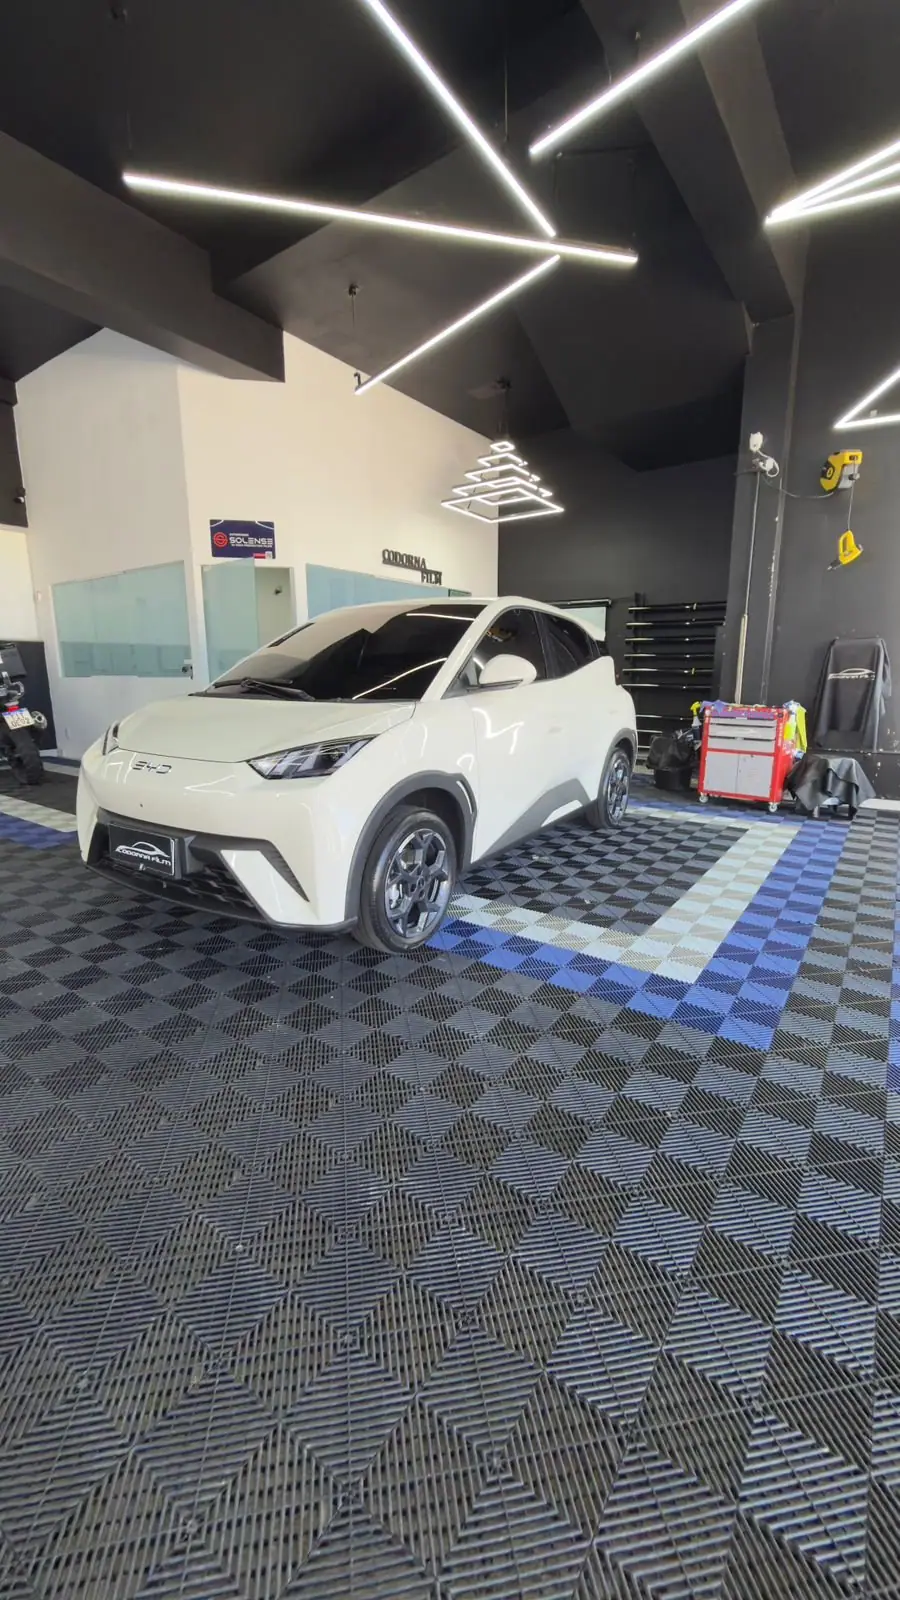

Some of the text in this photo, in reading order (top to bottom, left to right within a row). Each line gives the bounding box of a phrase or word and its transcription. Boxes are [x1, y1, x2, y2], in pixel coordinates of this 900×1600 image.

[229, 536, 273, 545] SOLENSE
[382, 549, 427, 570] CODORNA
[132, 760, 172, 774] BYD
